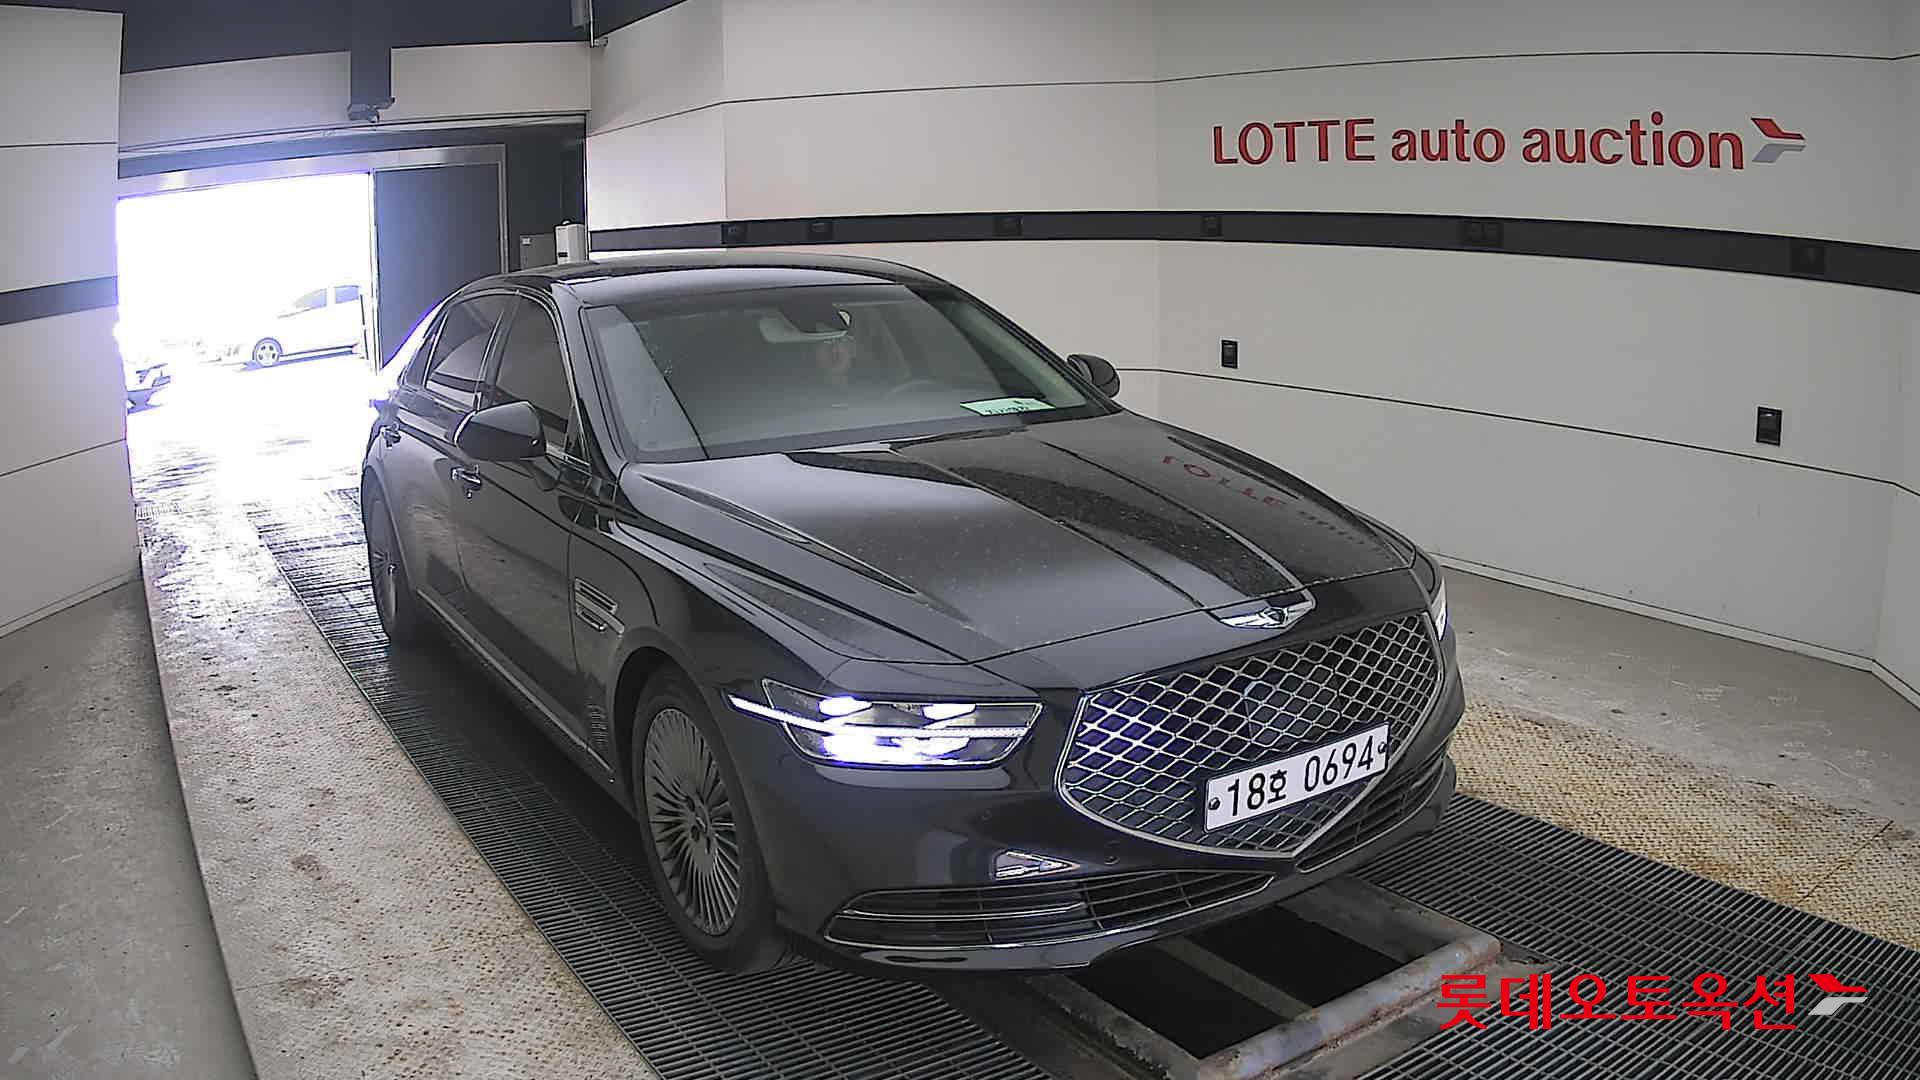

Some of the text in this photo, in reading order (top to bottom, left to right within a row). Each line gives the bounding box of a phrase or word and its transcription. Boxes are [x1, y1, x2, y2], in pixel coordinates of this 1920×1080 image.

[1212, 111, 1745, 170] LOTTE auto auction
[1227, 735, 1374, 816] 18호 0694
